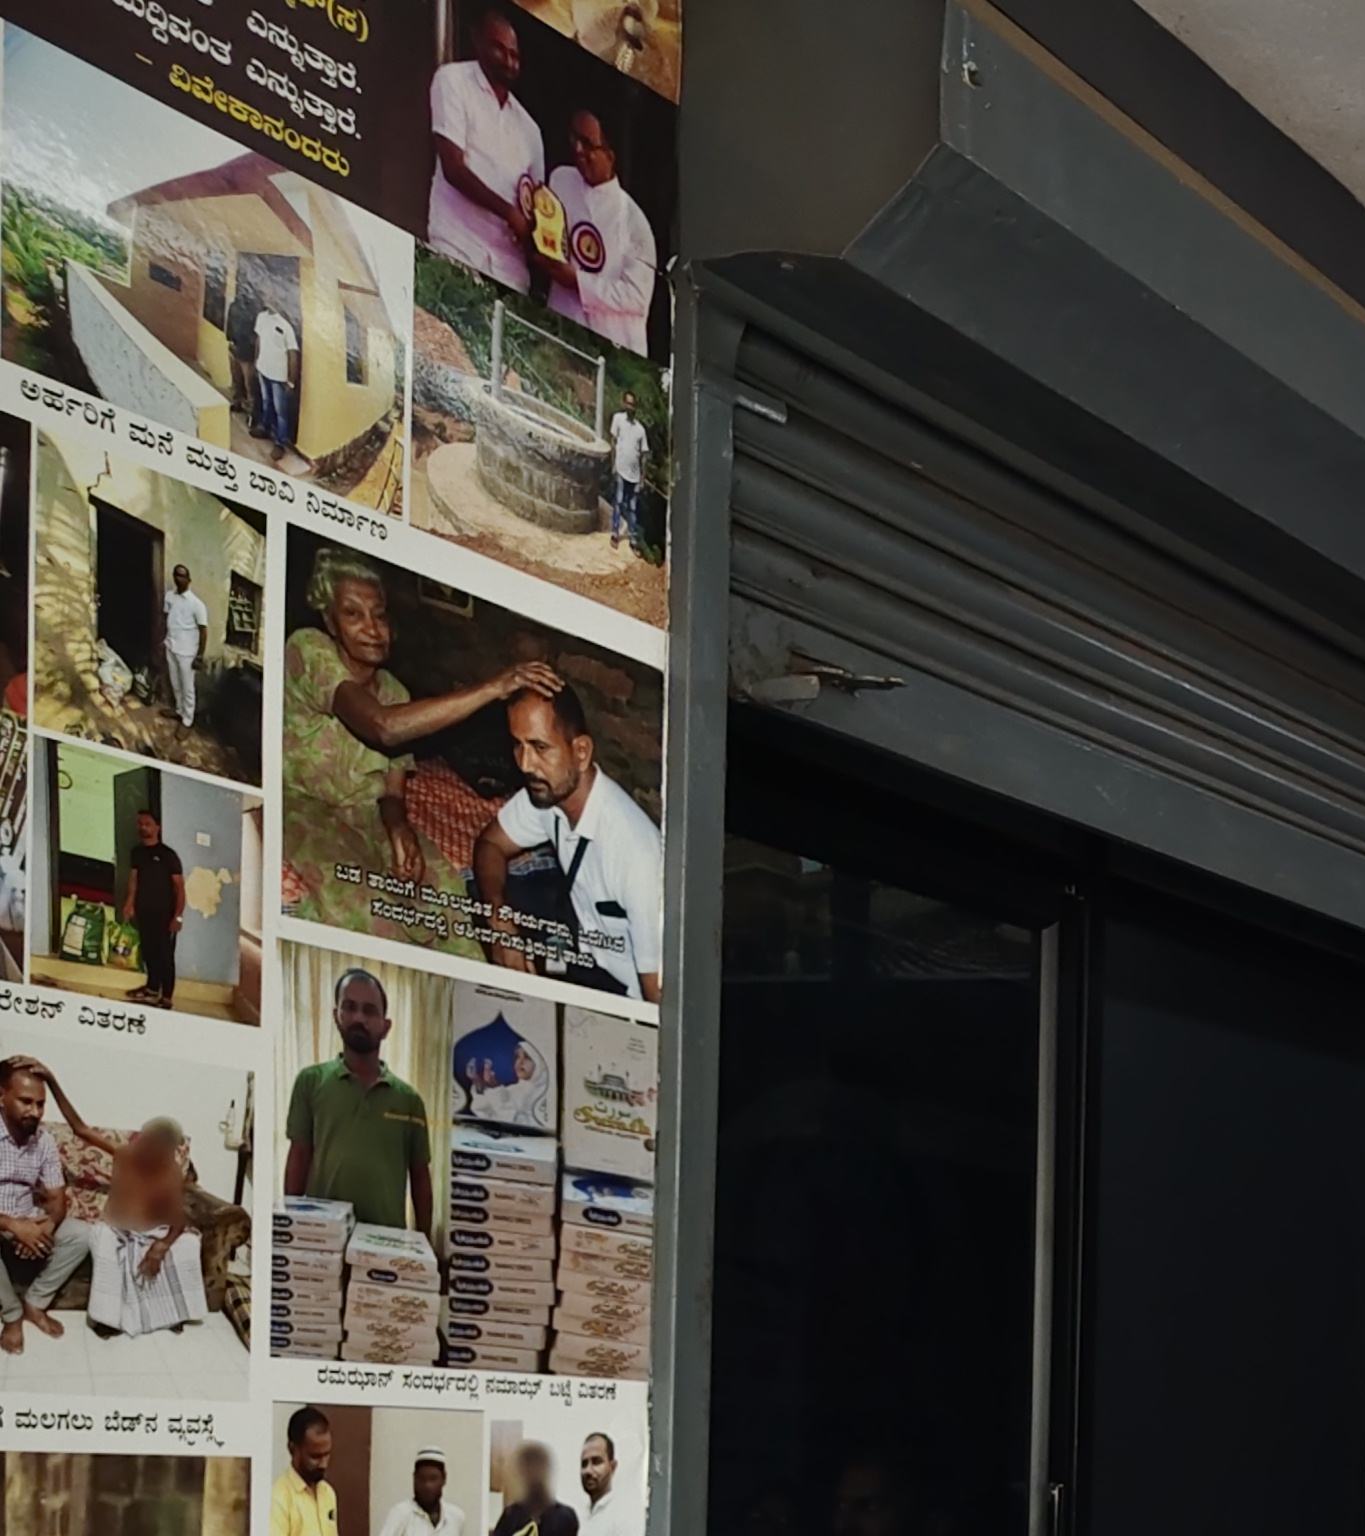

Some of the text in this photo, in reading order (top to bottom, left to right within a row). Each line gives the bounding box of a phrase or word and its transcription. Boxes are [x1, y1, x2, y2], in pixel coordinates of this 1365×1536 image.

[168, 63, 350, 178] ವಿವೇಕಾನಂದರು
[20, 377, 389, 541] ಅರ್ಹರಿಗೆ ಮನೆ ಮತ್ತು ಬಾವಿ ನಿರ್ಮಾಣ
[78, 1005, 147, 1035] ವಿತರಣೆ
[15, 1408, 94, 1430] ಮಲಗಲು
